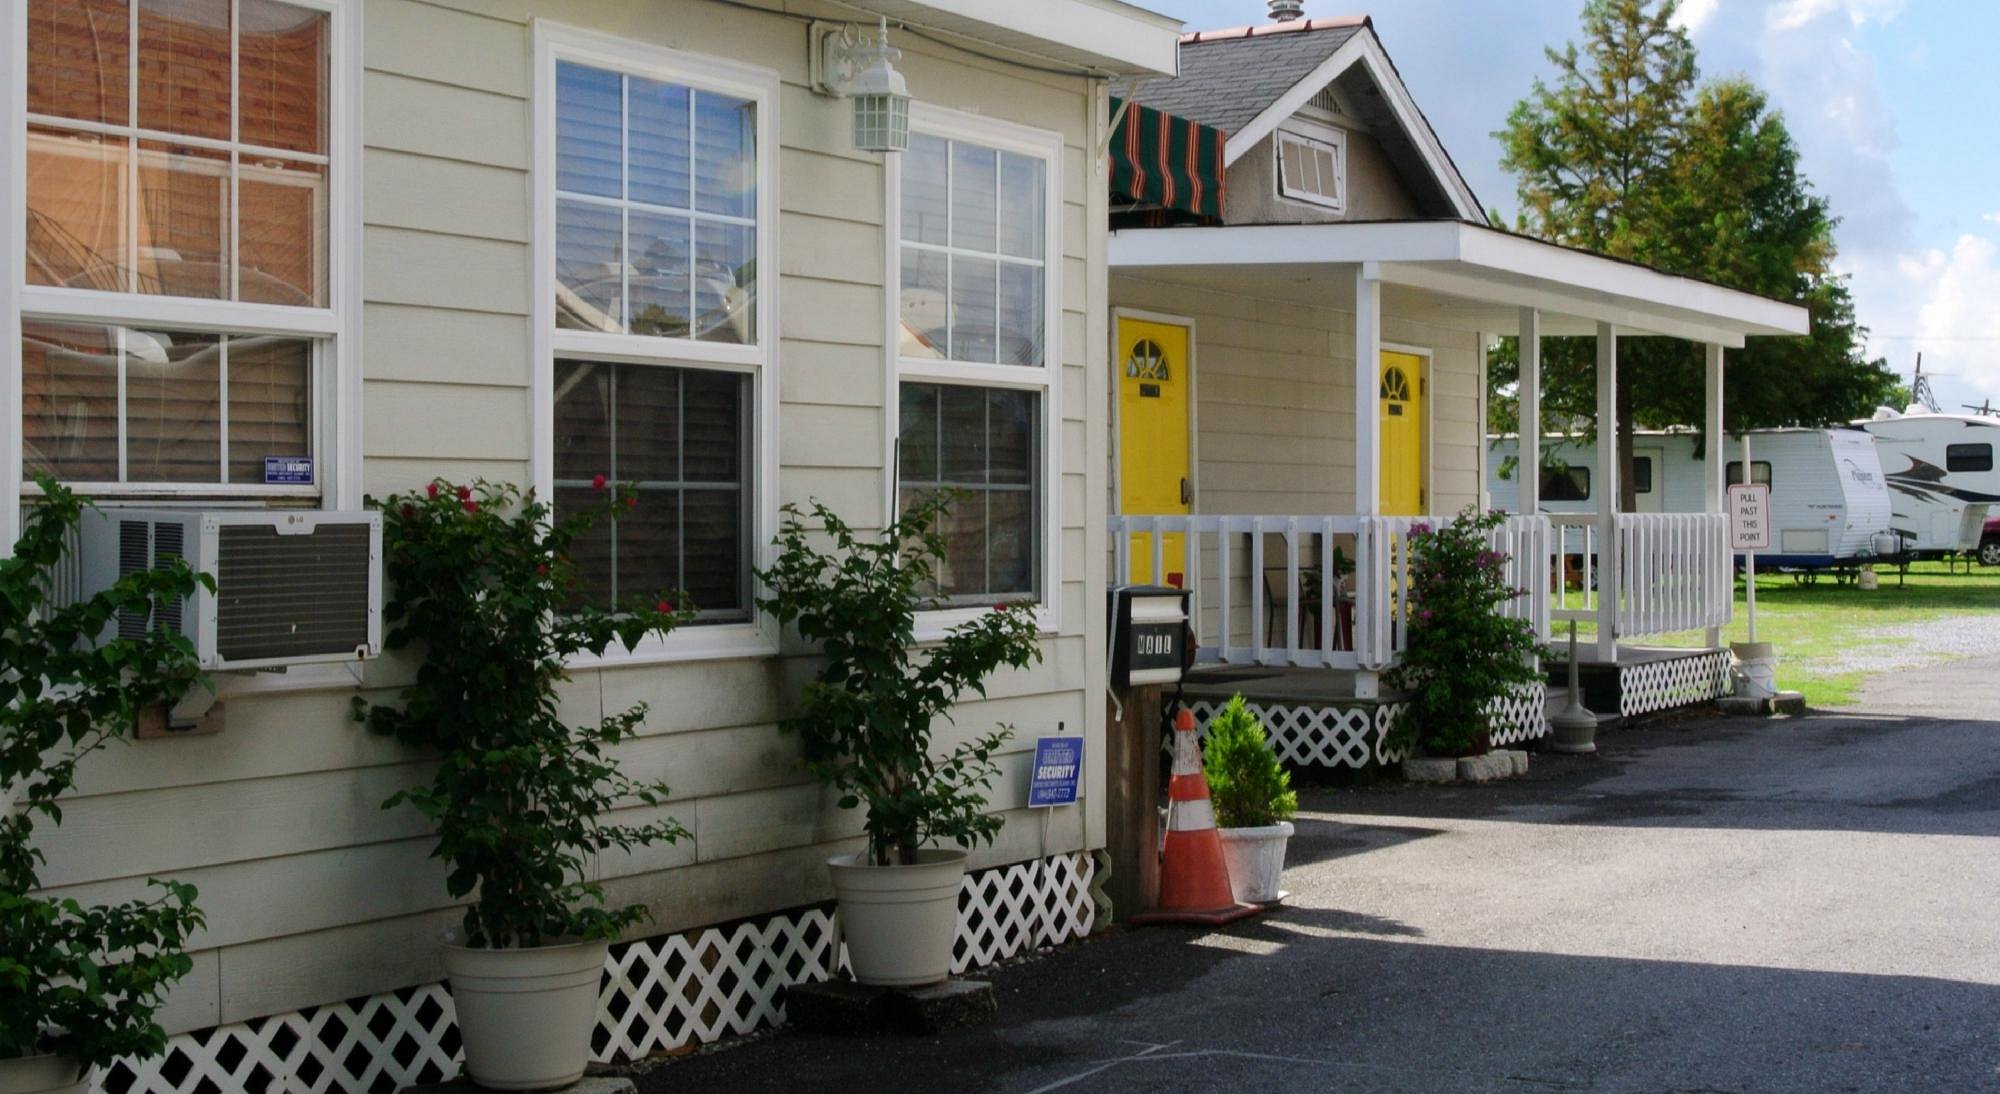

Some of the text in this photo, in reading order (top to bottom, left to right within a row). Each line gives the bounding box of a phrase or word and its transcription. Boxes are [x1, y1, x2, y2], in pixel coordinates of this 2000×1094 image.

[1740, 494, 1757, 502] PULL
[1740, 507, 1757, 515] PAST
[296, 515, 304, 523] LG
[1743, 520, 1757, 528] THIS
[1740, 533, 1760, 541] POINT
[1138, 634, 1172, 654] MAIL
[1038, 765, 1076, 779] SECURITY
